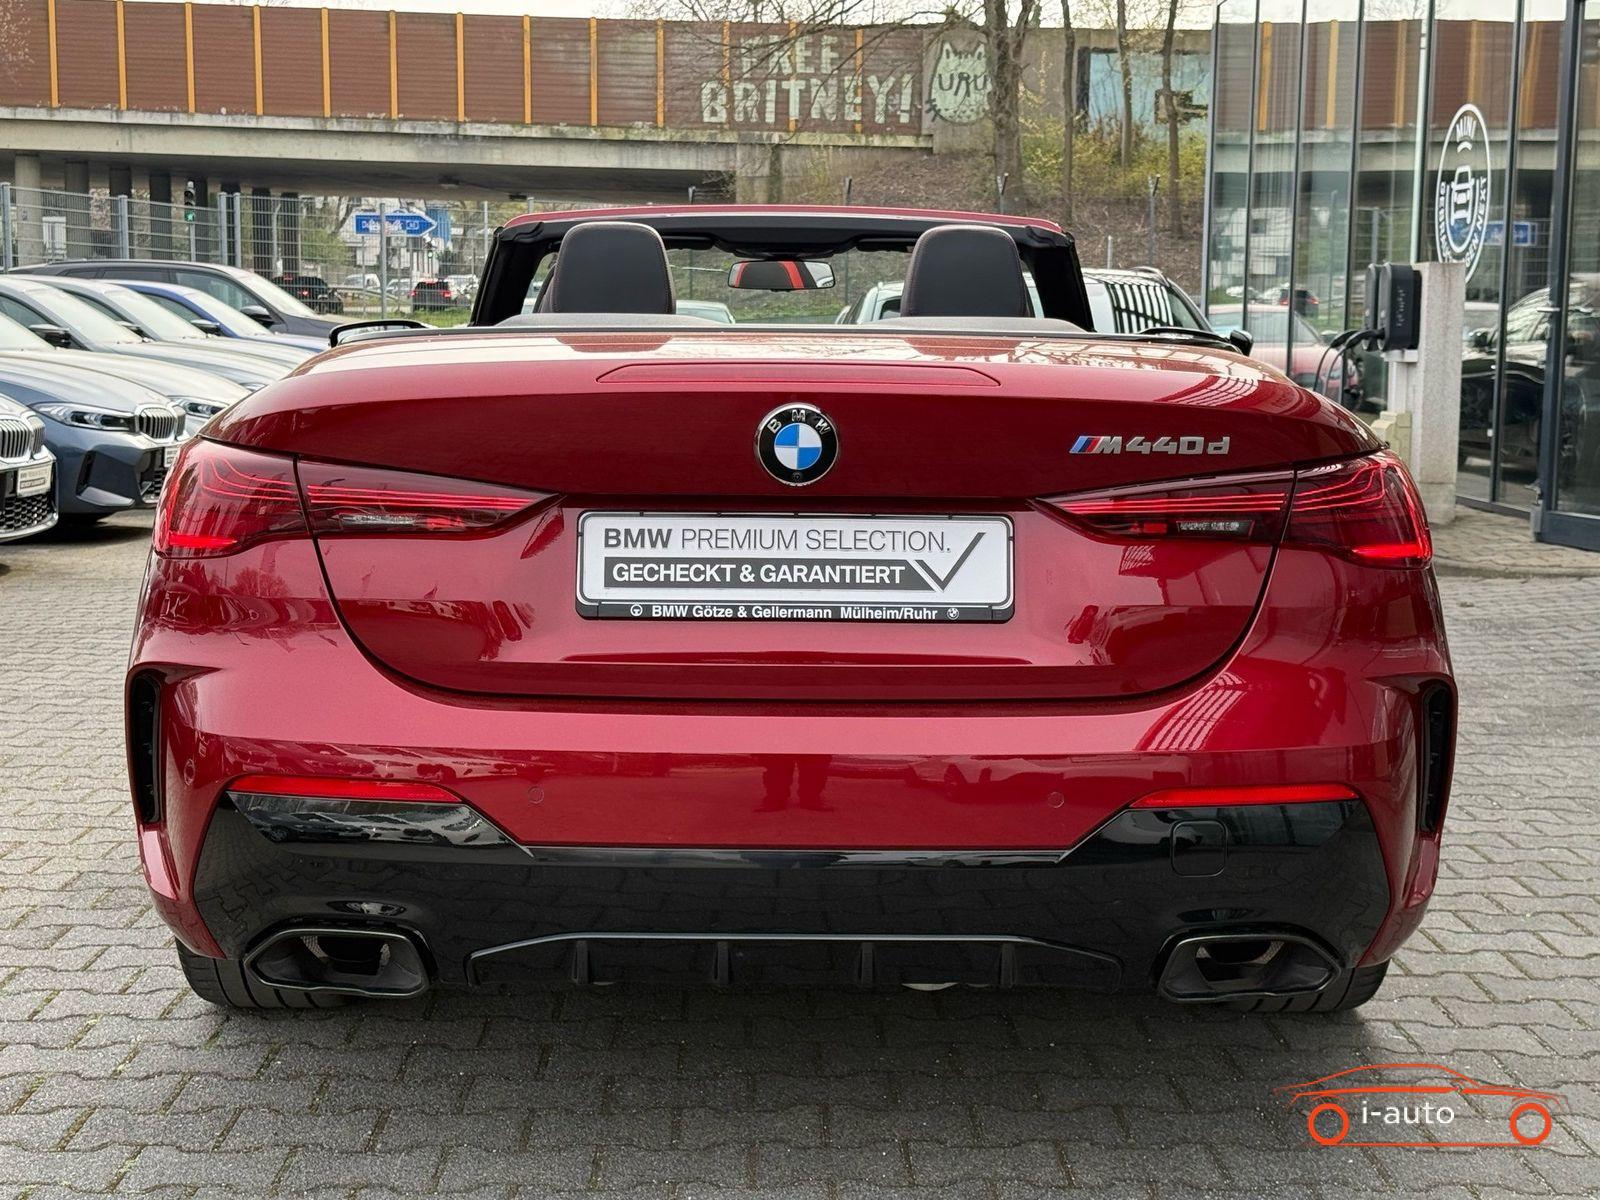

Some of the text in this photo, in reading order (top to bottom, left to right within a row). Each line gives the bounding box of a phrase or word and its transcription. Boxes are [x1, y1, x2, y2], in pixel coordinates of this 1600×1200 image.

[740, 34, 839, 78] FREE
[700, 73, 913, 124] BRITNEY!
[1456, 115, 1477, 143] MINI
[766, 409, 832, 435] BMW
[1092, 436, 1230, 454] M440d
[603, 528, 951, 552] BMW PREMIUM SELECTION.
[612, 563, 906, 584] GECHECKT & GARANTIERT
[651, 605, 938, 620] BMW Götze & Gellermann Mülheim/Ruhr
